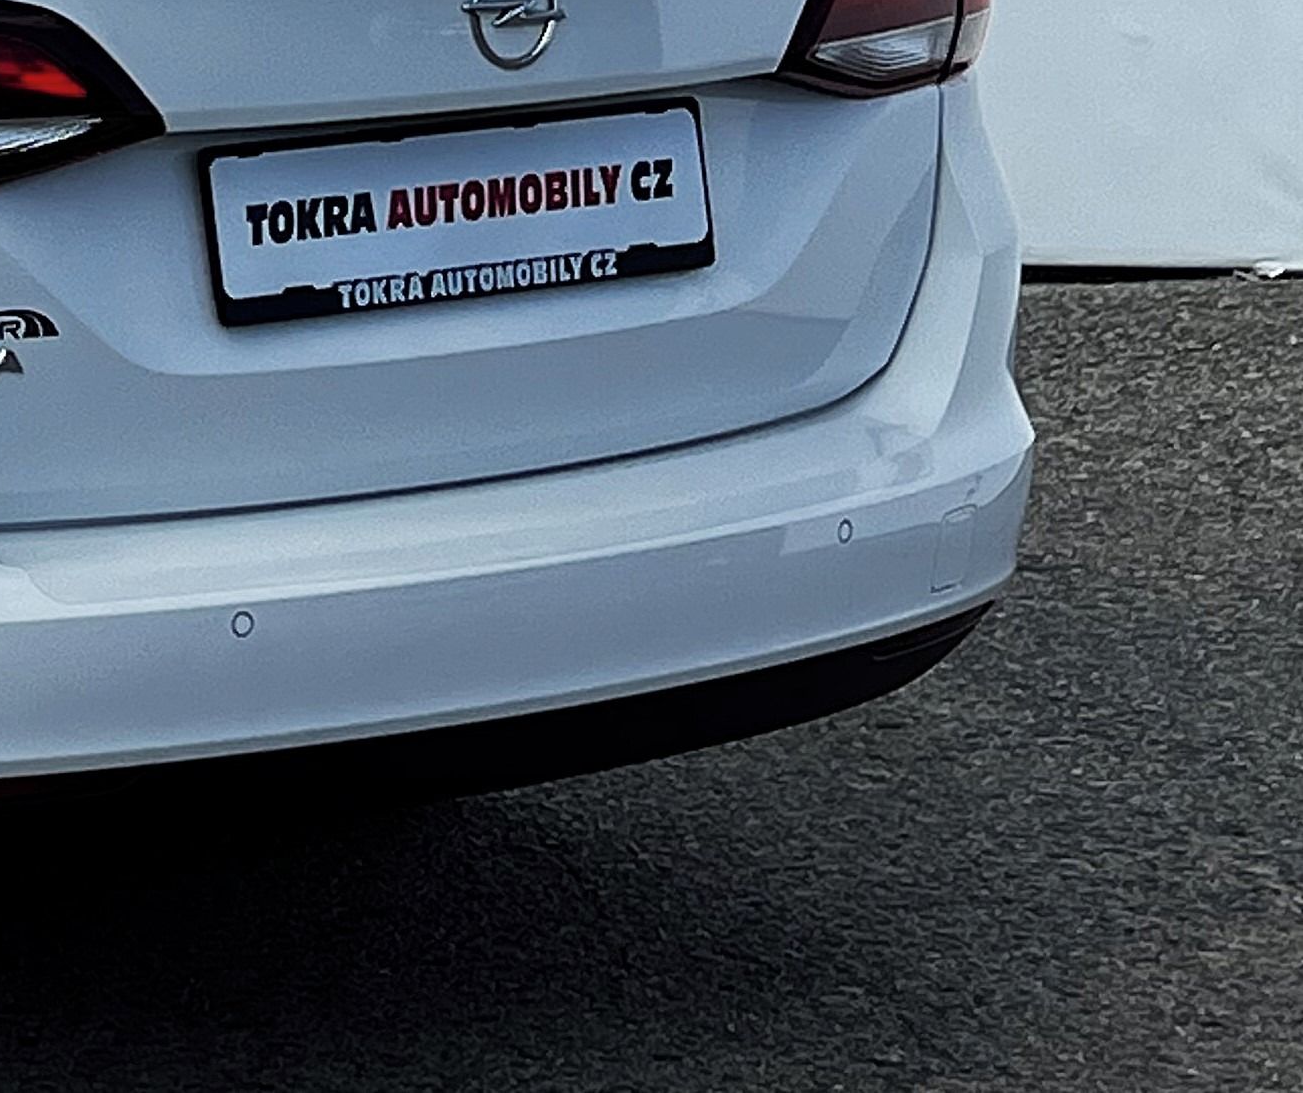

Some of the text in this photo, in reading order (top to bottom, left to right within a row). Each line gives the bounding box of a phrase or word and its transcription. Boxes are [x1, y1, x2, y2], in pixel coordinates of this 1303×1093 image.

[246, 158, 673, 246] TOKRA AUTOMOBILY CZ
[337, 252, 618, 309] TOKRA AUTOMOBILY CZ
